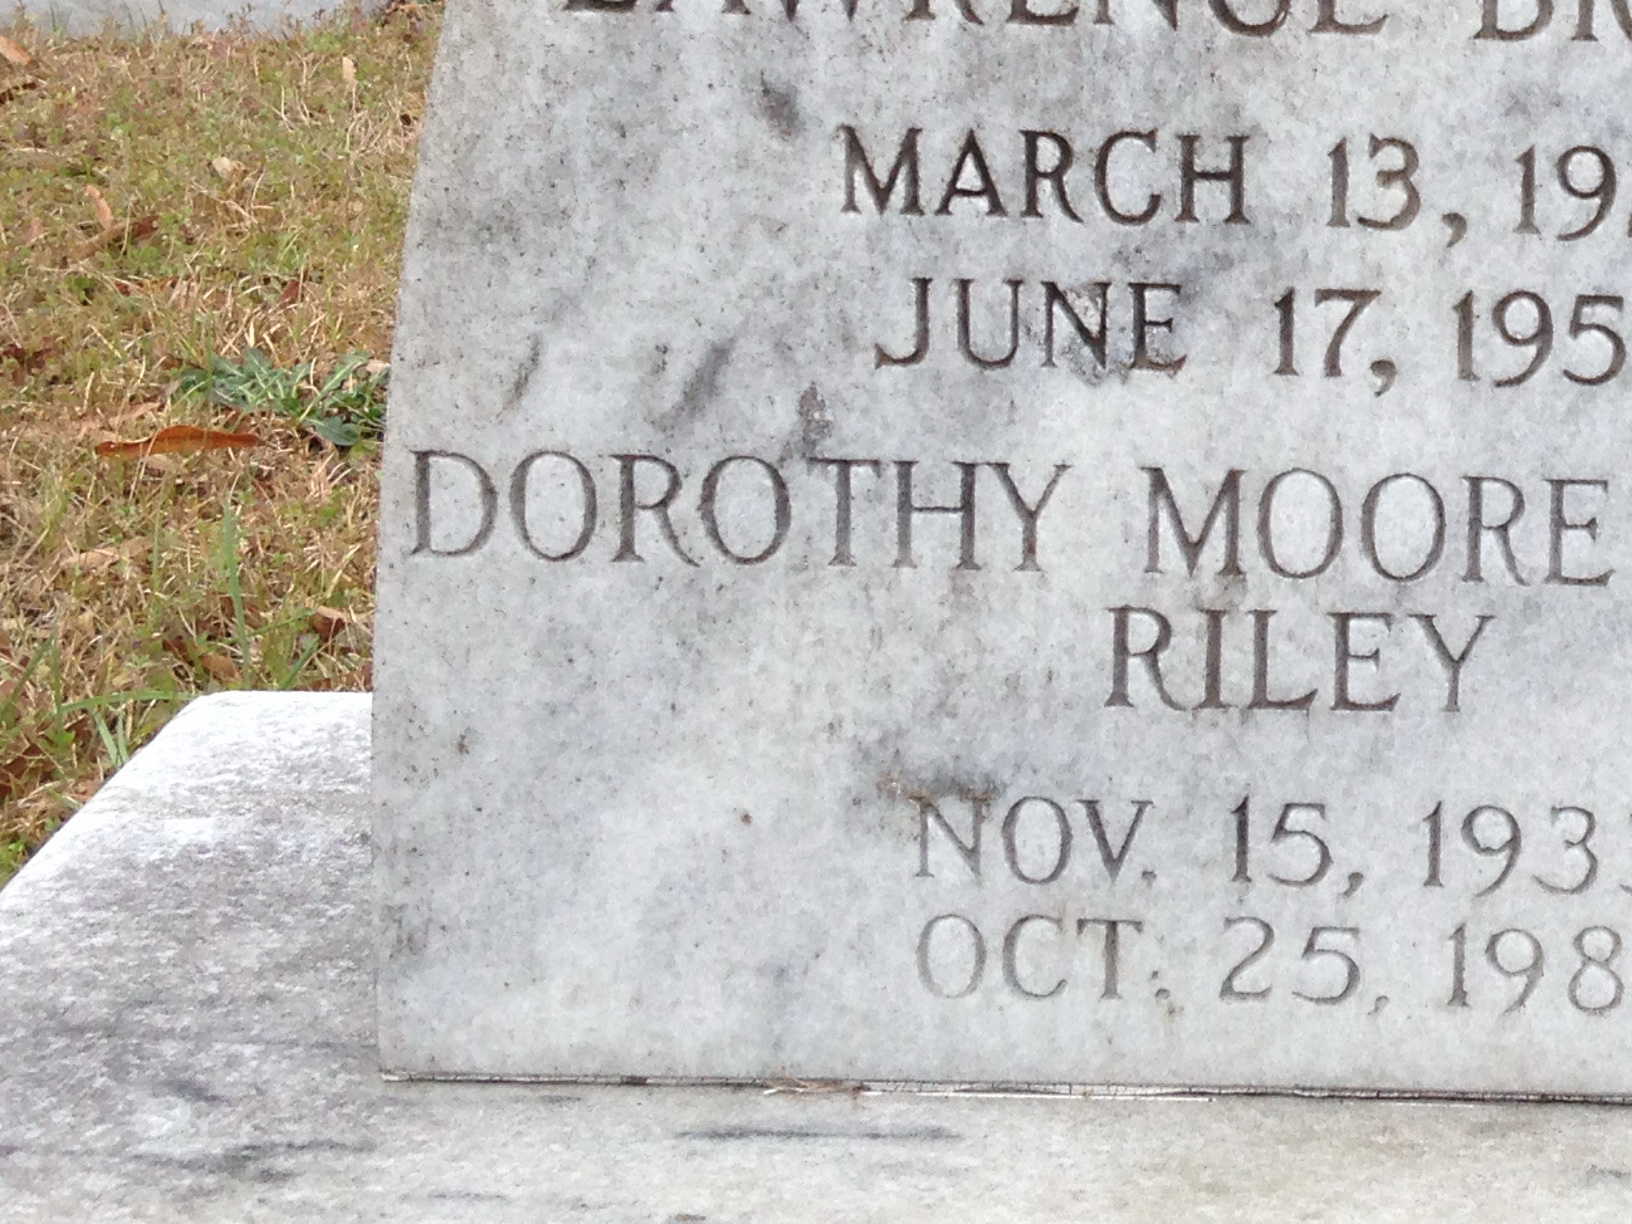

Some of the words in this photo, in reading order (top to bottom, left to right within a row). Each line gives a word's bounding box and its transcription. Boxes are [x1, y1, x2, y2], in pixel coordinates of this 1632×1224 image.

[836, 124, 1251, 226] MARCH
[1325, 136, 1468, 248] 13,
[874, 277, 1188, 373] JUNE
[1272, 286, 1397, 397] 17,
[409, 448, 1073, 573] DOROTHY
[1140, 466, 1616, 587] MOORE
[1104, 604, 1495, 712] RILEY
[911, 791, 1157, 884] NOV.
[1229, 794, 1365, 898] 15,
[916, 912, 1172, 1002] OCT.
[1218, 915, 1391, 1015] 25,
